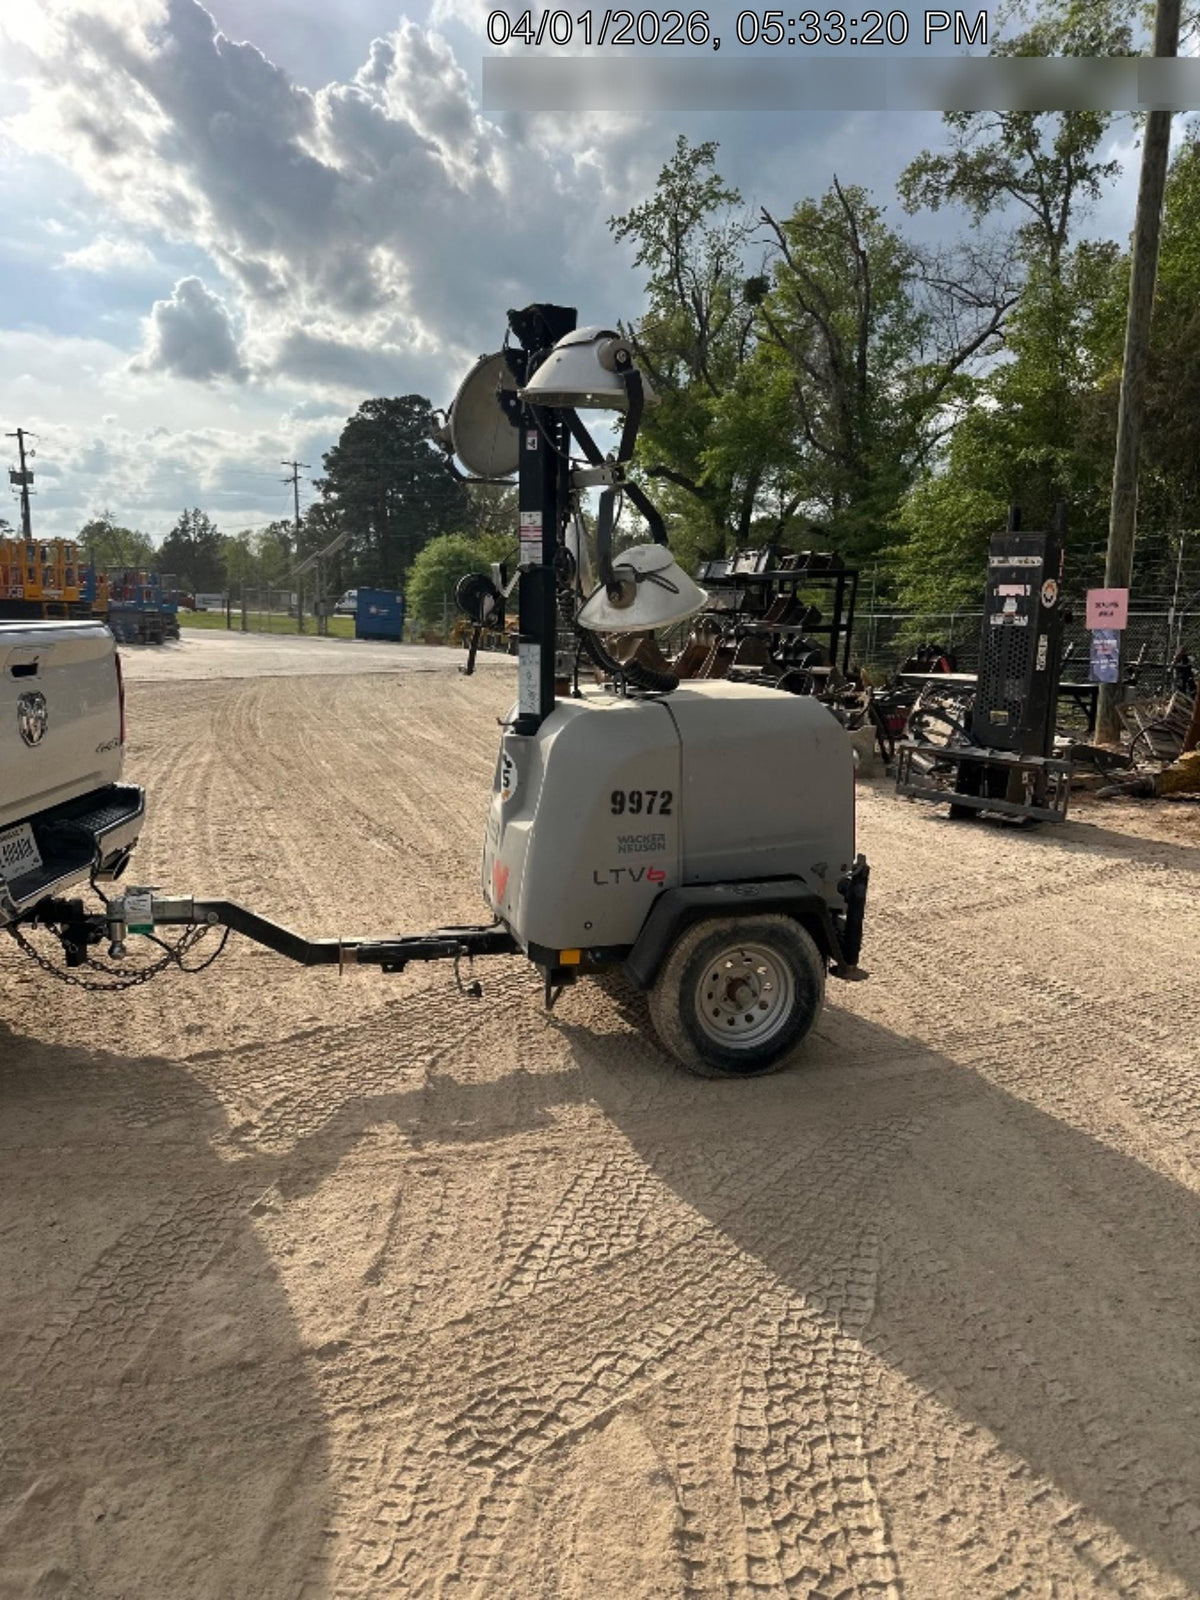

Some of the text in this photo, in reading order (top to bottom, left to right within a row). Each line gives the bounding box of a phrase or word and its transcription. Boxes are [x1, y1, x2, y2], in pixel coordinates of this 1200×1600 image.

[610, 790, 673, 815] 9972
[616, 834, 666, 844] WACKER
[617, 842, 666, 854] NEUSON
